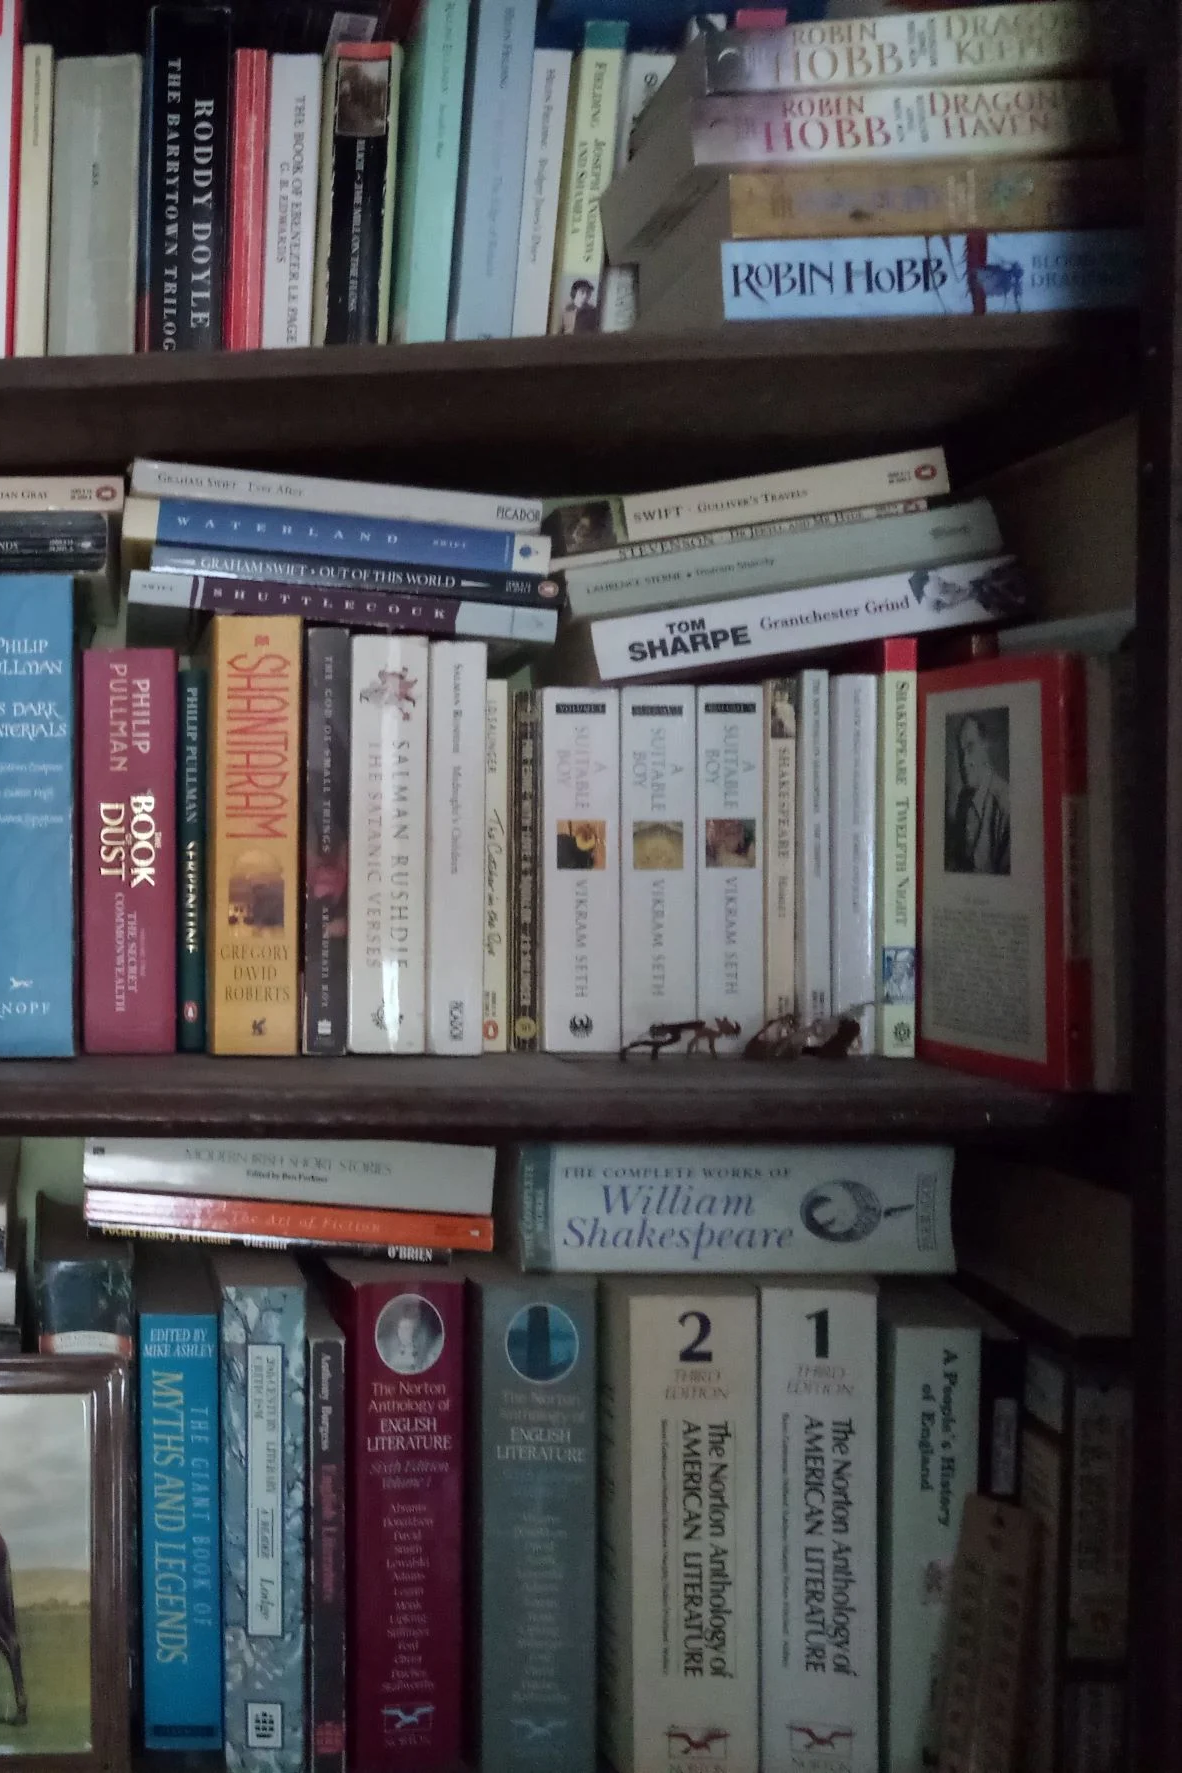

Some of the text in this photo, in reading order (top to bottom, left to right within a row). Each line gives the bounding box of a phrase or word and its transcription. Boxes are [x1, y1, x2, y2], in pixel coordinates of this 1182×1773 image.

[763, 116, 892, 153] HOBB
[780, 95, 865, 119] ROBIN
[161, 57, 183, 353] THE BARRYTOWN TRILOG
[188, 97, 215, 330] RODDY DOYLE
[632, 503, 685, 525] SWIFT
[200, 556, 457, 589] GRAHAM SWIFT OUT OF THIS WORLD
[627, 594, 911, 663] SHARPE Grantchester Grind
[665, 616, 707, 635] TOM
[12, 701, 61, 720] DARK
[109, 662, 129, 773] PULLMAN
[131, 677, 151, 754] PHILIP
[224, 652, 292, 840] SHANTARAM
[894, 680, 910, 786] SHAKESPEARE
[321, 749, 333, 795] SMALL
[98, 802, 128, 881] DUST
[129, 793, 157, 888] BOOK
[321, 799, 333, 854] THINGS
[390, 740, 410, 969] SALMAN RUSHDIE
[601, 1182, 756, 1218] William
[562, 1216, 796, 1261] Shakespeare
[143, 1343, 215, 1359] MIKE ASHLEY
[678, 1310, 713, 1362] 2
[804, 1307, 830, 1359] 1
[370, 1379, 447, 1397] The Norton
[366, 1433, 452, 1452] LITERATURE
[379, 1416, 438, 1434] ENGLISH
[918, 1383, 936, 1492] of England
[937, 1348, 959, 1528] A People's History
[150, 1368, 188, 1665] MYTHS AND LEGENDS
[189, 1405, 213, 1627] THE GIANT BOOK OF
[680, 1419, 704, 1679] AMERICAN LITERATURE
[704, 1420, 735, 1679] The Norton Anthology of
[803, 1413, 826, 1673] AMERICAN LITERATURE
[826, 1416, 861, 1679] The Norton Anthology of
